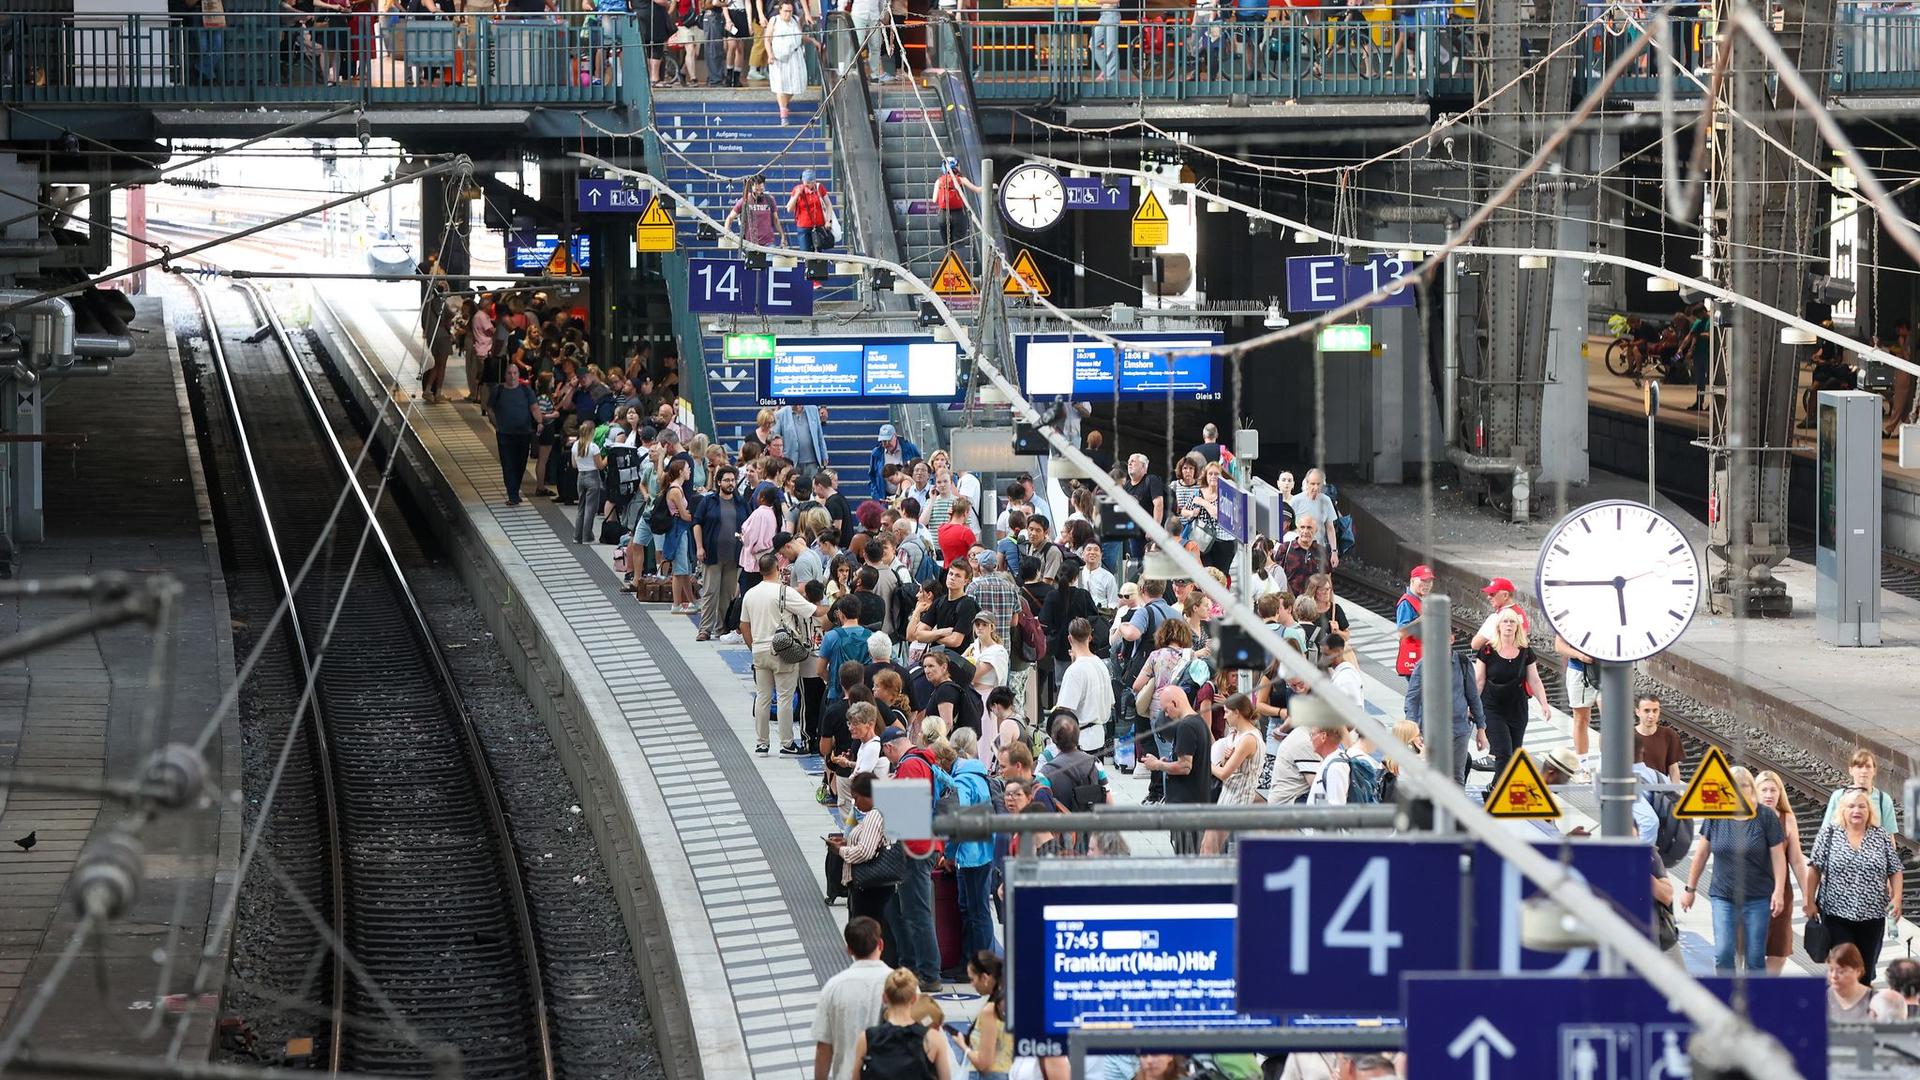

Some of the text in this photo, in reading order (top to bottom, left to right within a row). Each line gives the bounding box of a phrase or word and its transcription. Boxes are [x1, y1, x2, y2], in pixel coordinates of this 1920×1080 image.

[716, 131, 738, 139] Aufgang
[718, 145, 743, 153] Nordsteg
[697, 264, 792, 306] 14 E
[1310, 258, 1405, 301] E 13
[1124, 360, 1153, 369] Elmshorn
[759, 398, 786, 406] Gleis 14
[1263, 855, 1403, 976] 14
[1055, 931, 1099, 950] 17:45
[1054, 951, 1217, 975] Frankfurt(Main)Hbf
[1018, 1038, 1062, 1056] Gleis
